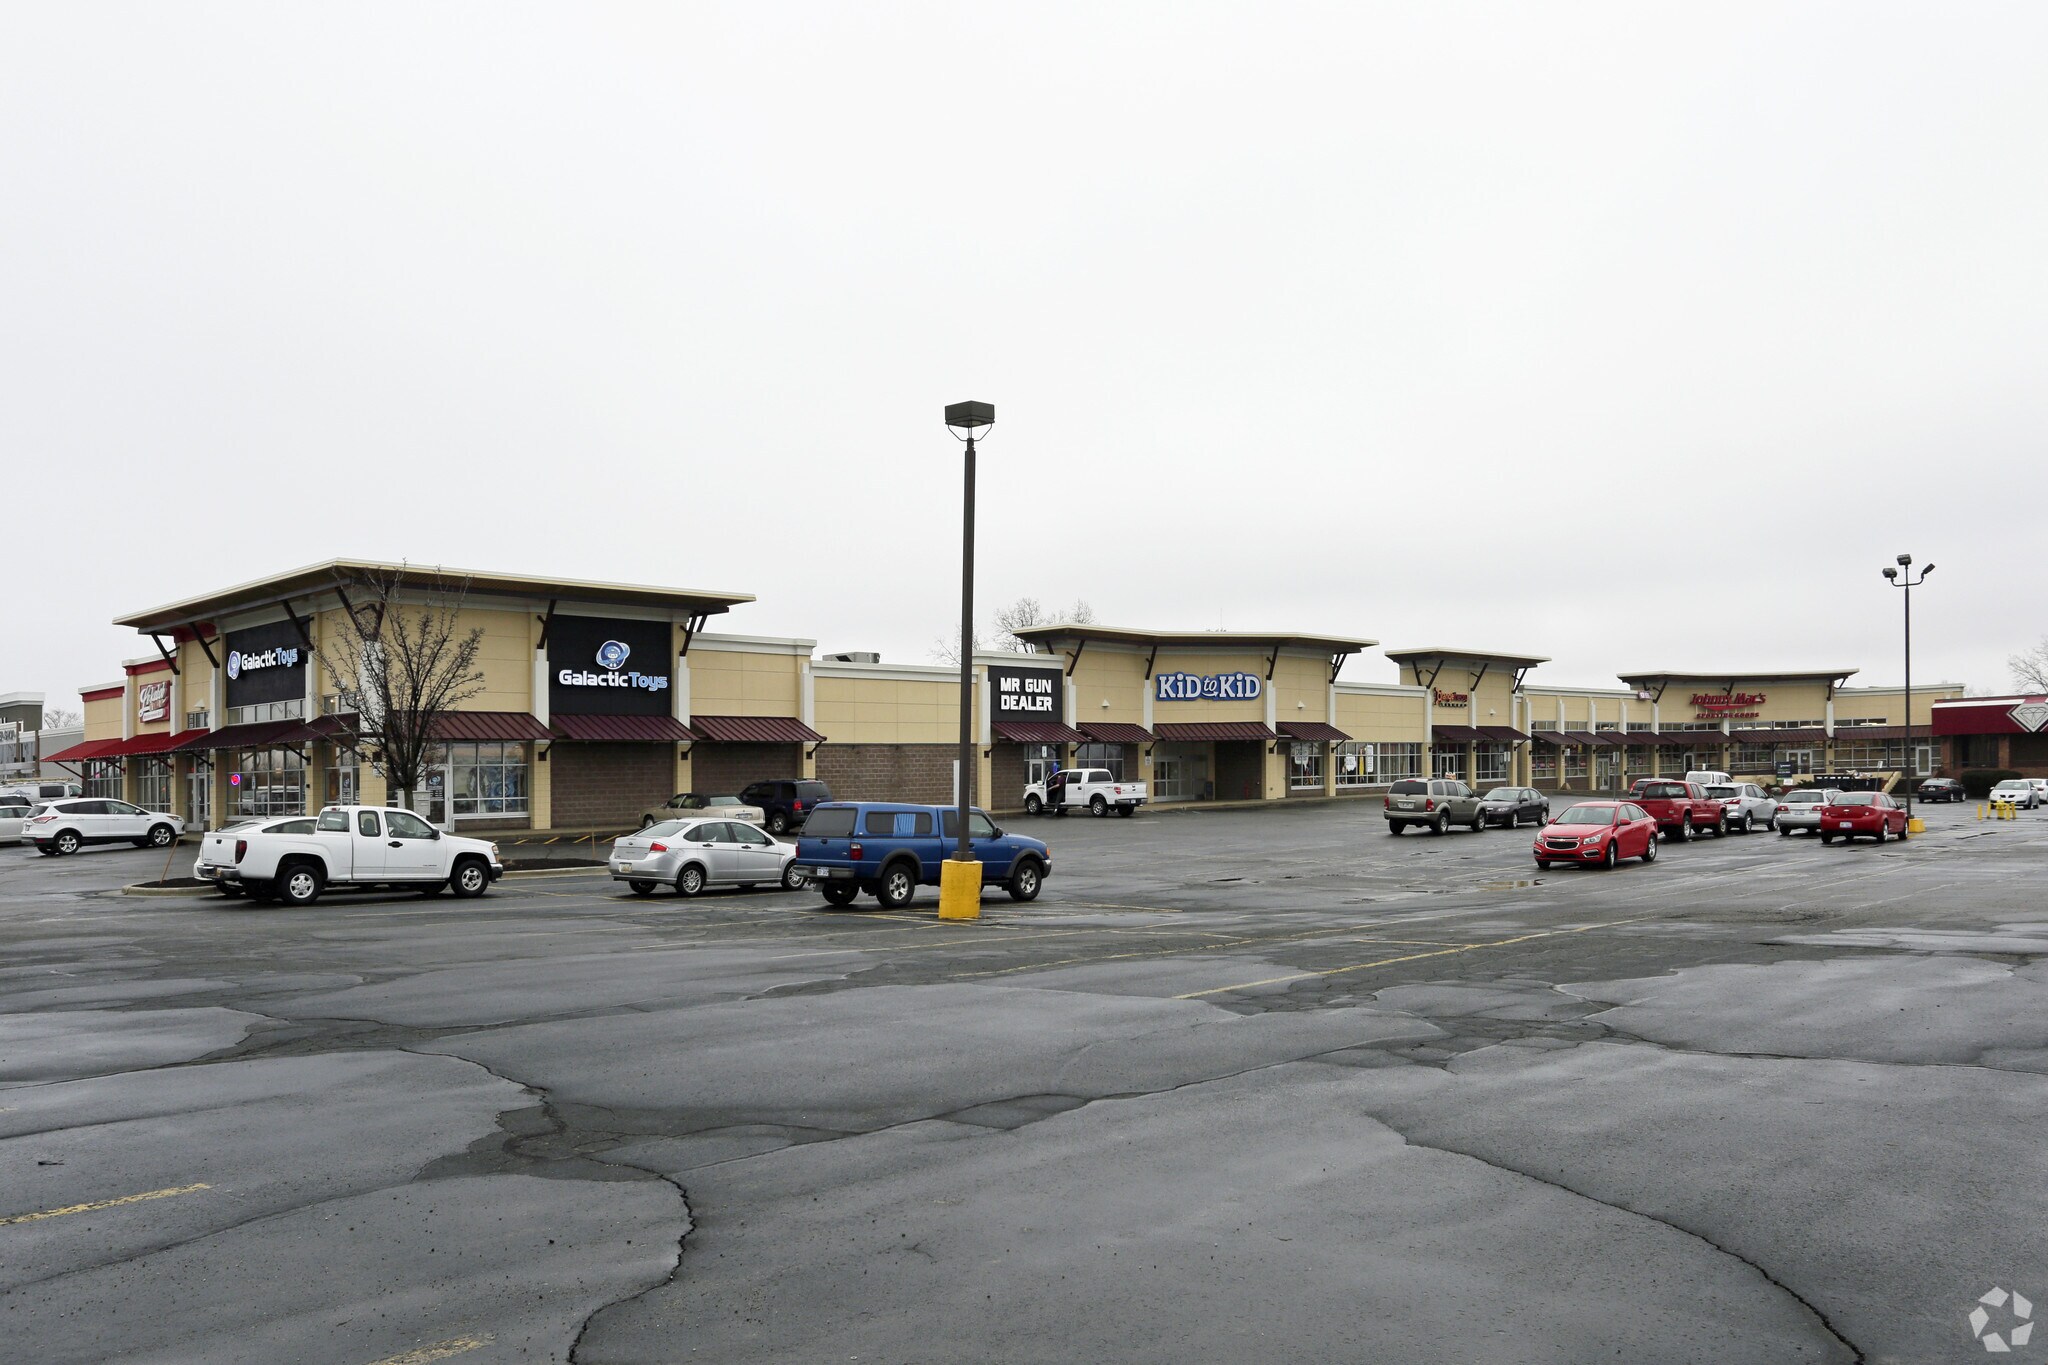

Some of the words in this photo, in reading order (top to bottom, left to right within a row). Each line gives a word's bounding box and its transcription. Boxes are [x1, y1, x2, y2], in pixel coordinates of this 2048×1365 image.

[1000, 677, 1020, 692] MR
[1025, 678, 1052, 693] GUN
[1203, 677, 1218, 691] to
[1000, 694, 1053, 711] DEALER
[1690, 693, 1733, 705] Johnny
[1733, 692, 1766, 705] Mac's
